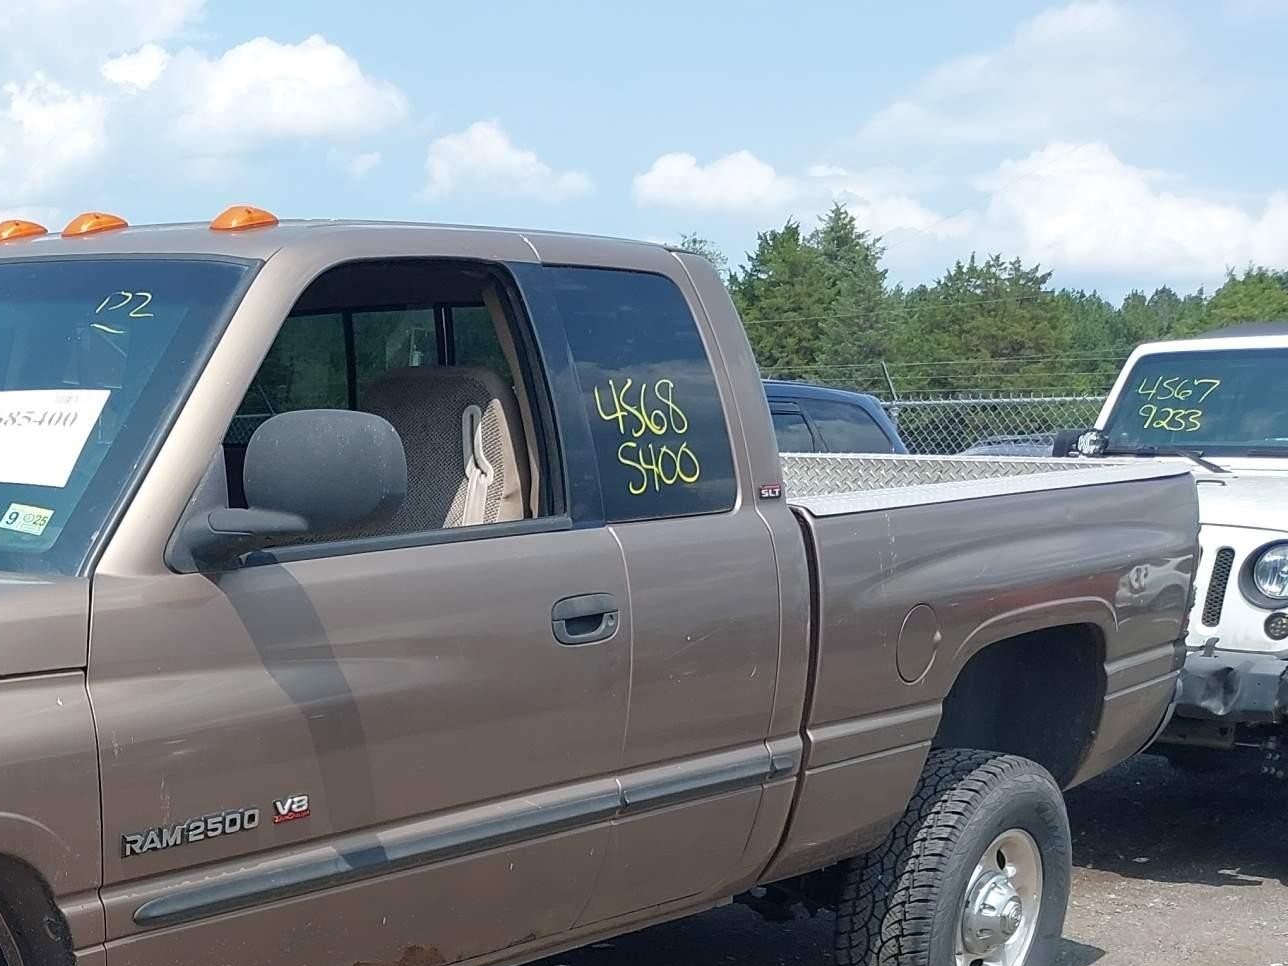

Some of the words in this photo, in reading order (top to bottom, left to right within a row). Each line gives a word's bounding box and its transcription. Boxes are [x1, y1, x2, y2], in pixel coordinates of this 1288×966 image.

[1138, 376, 1221, 403] 4567
[594, 379, 688, 438] 4568
[1138, 404, 1202, 432] 9233
[618, 441, 701, 495] 5400
[761, 488, 780, 498] SLT
[6, 511, 20, 525] 9
[32, 514, 49, 527] 25
[274, 795, 309, 815] V8
[123, 826, 183, 857] RAM
[186, 808, 260, 843] 2500
